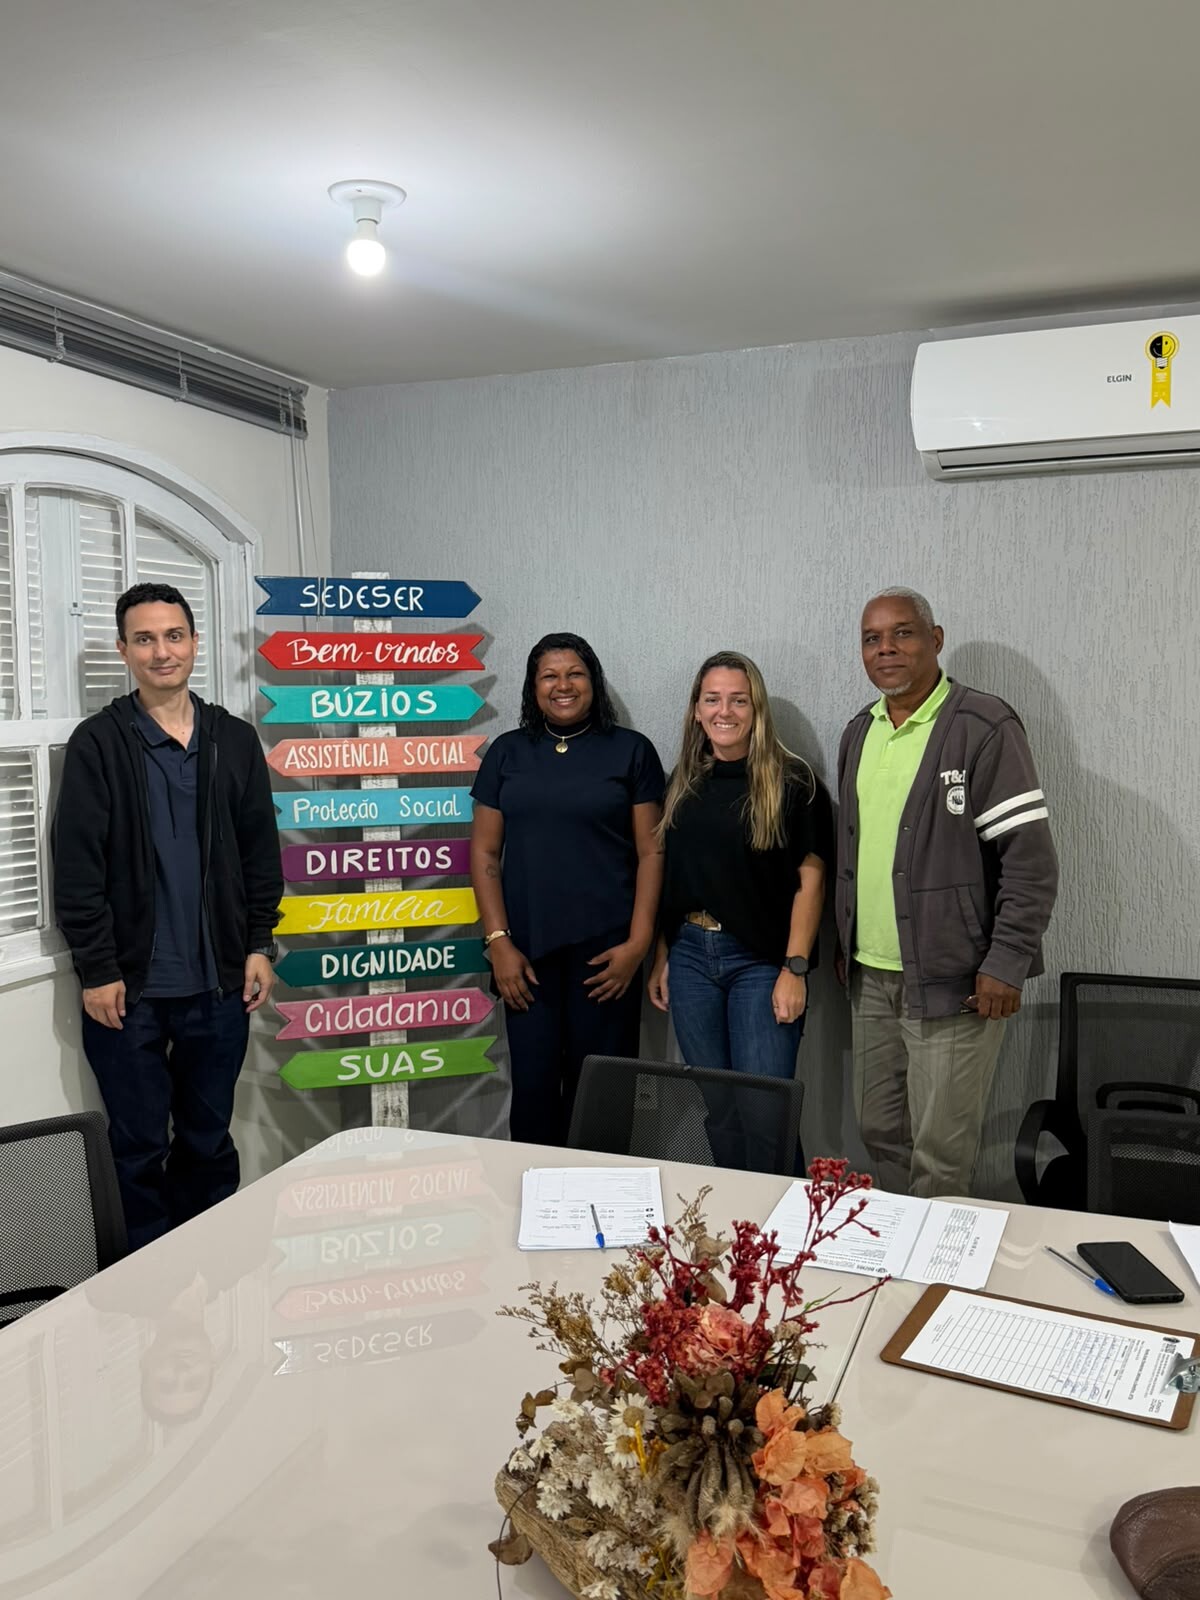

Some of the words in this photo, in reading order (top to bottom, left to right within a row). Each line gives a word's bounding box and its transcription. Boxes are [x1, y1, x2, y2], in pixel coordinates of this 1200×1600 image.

[1106, 373, 1132, 383] ELGIN
[300, 584, 424, 611] SEDESER
[286, 637, 460, 665] Bem-vindos
[311, 686, 437, 718] BÚZIOS
[284, 740, 389, 769] ASSISTÊNCIA
[403, 741, 466, 766] SOCIAL
[293, 797, 378, 823] Proteção
[399, 794, 461, 818] Social
[306, 846, 452, 875] DIREITOS
[307, 896, 459, 931] Família
[321, 945, 456, 978] DIGNIDADE
[305, 996, 471, 1033] Cidadania
[337, 1048, 445, 1081] SUAS
